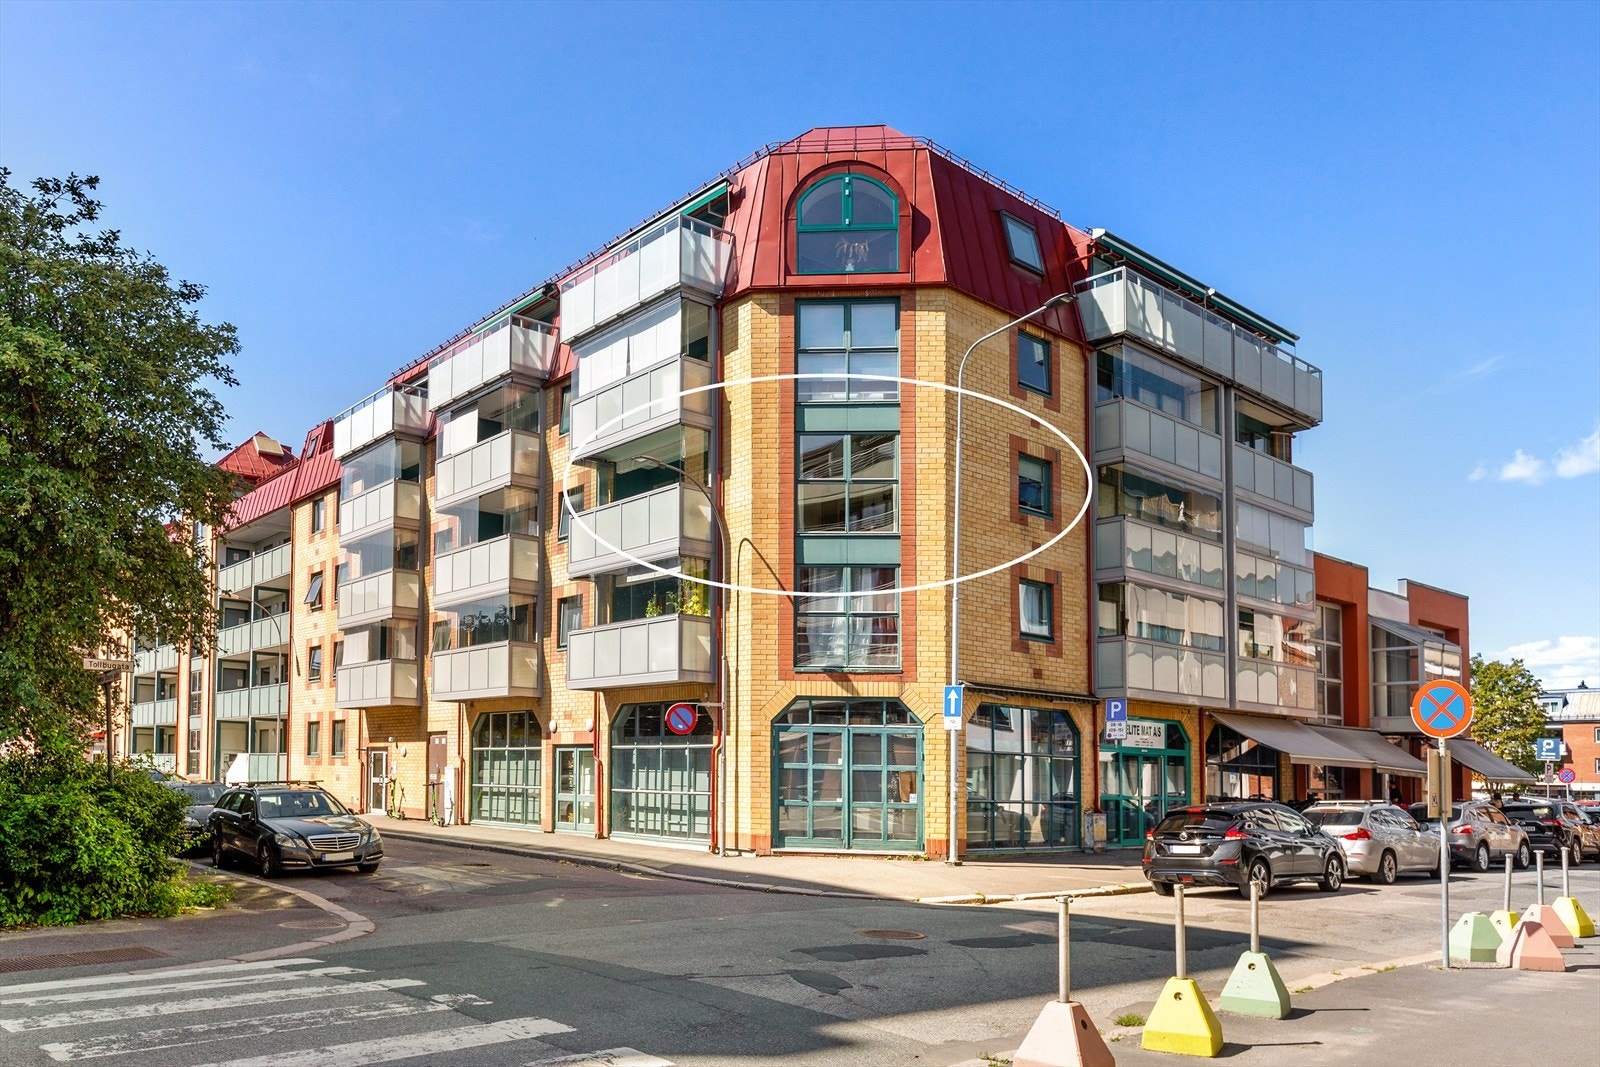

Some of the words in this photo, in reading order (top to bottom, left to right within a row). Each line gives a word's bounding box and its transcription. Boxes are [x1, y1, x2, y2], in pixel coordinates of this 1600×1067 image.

[88, 660, 130, 670] Tollbugata
[1111, 701, 1122, 719] P
[1141, 726, 1152, 737] MAT
[1546, 764, 1552, 774] P
